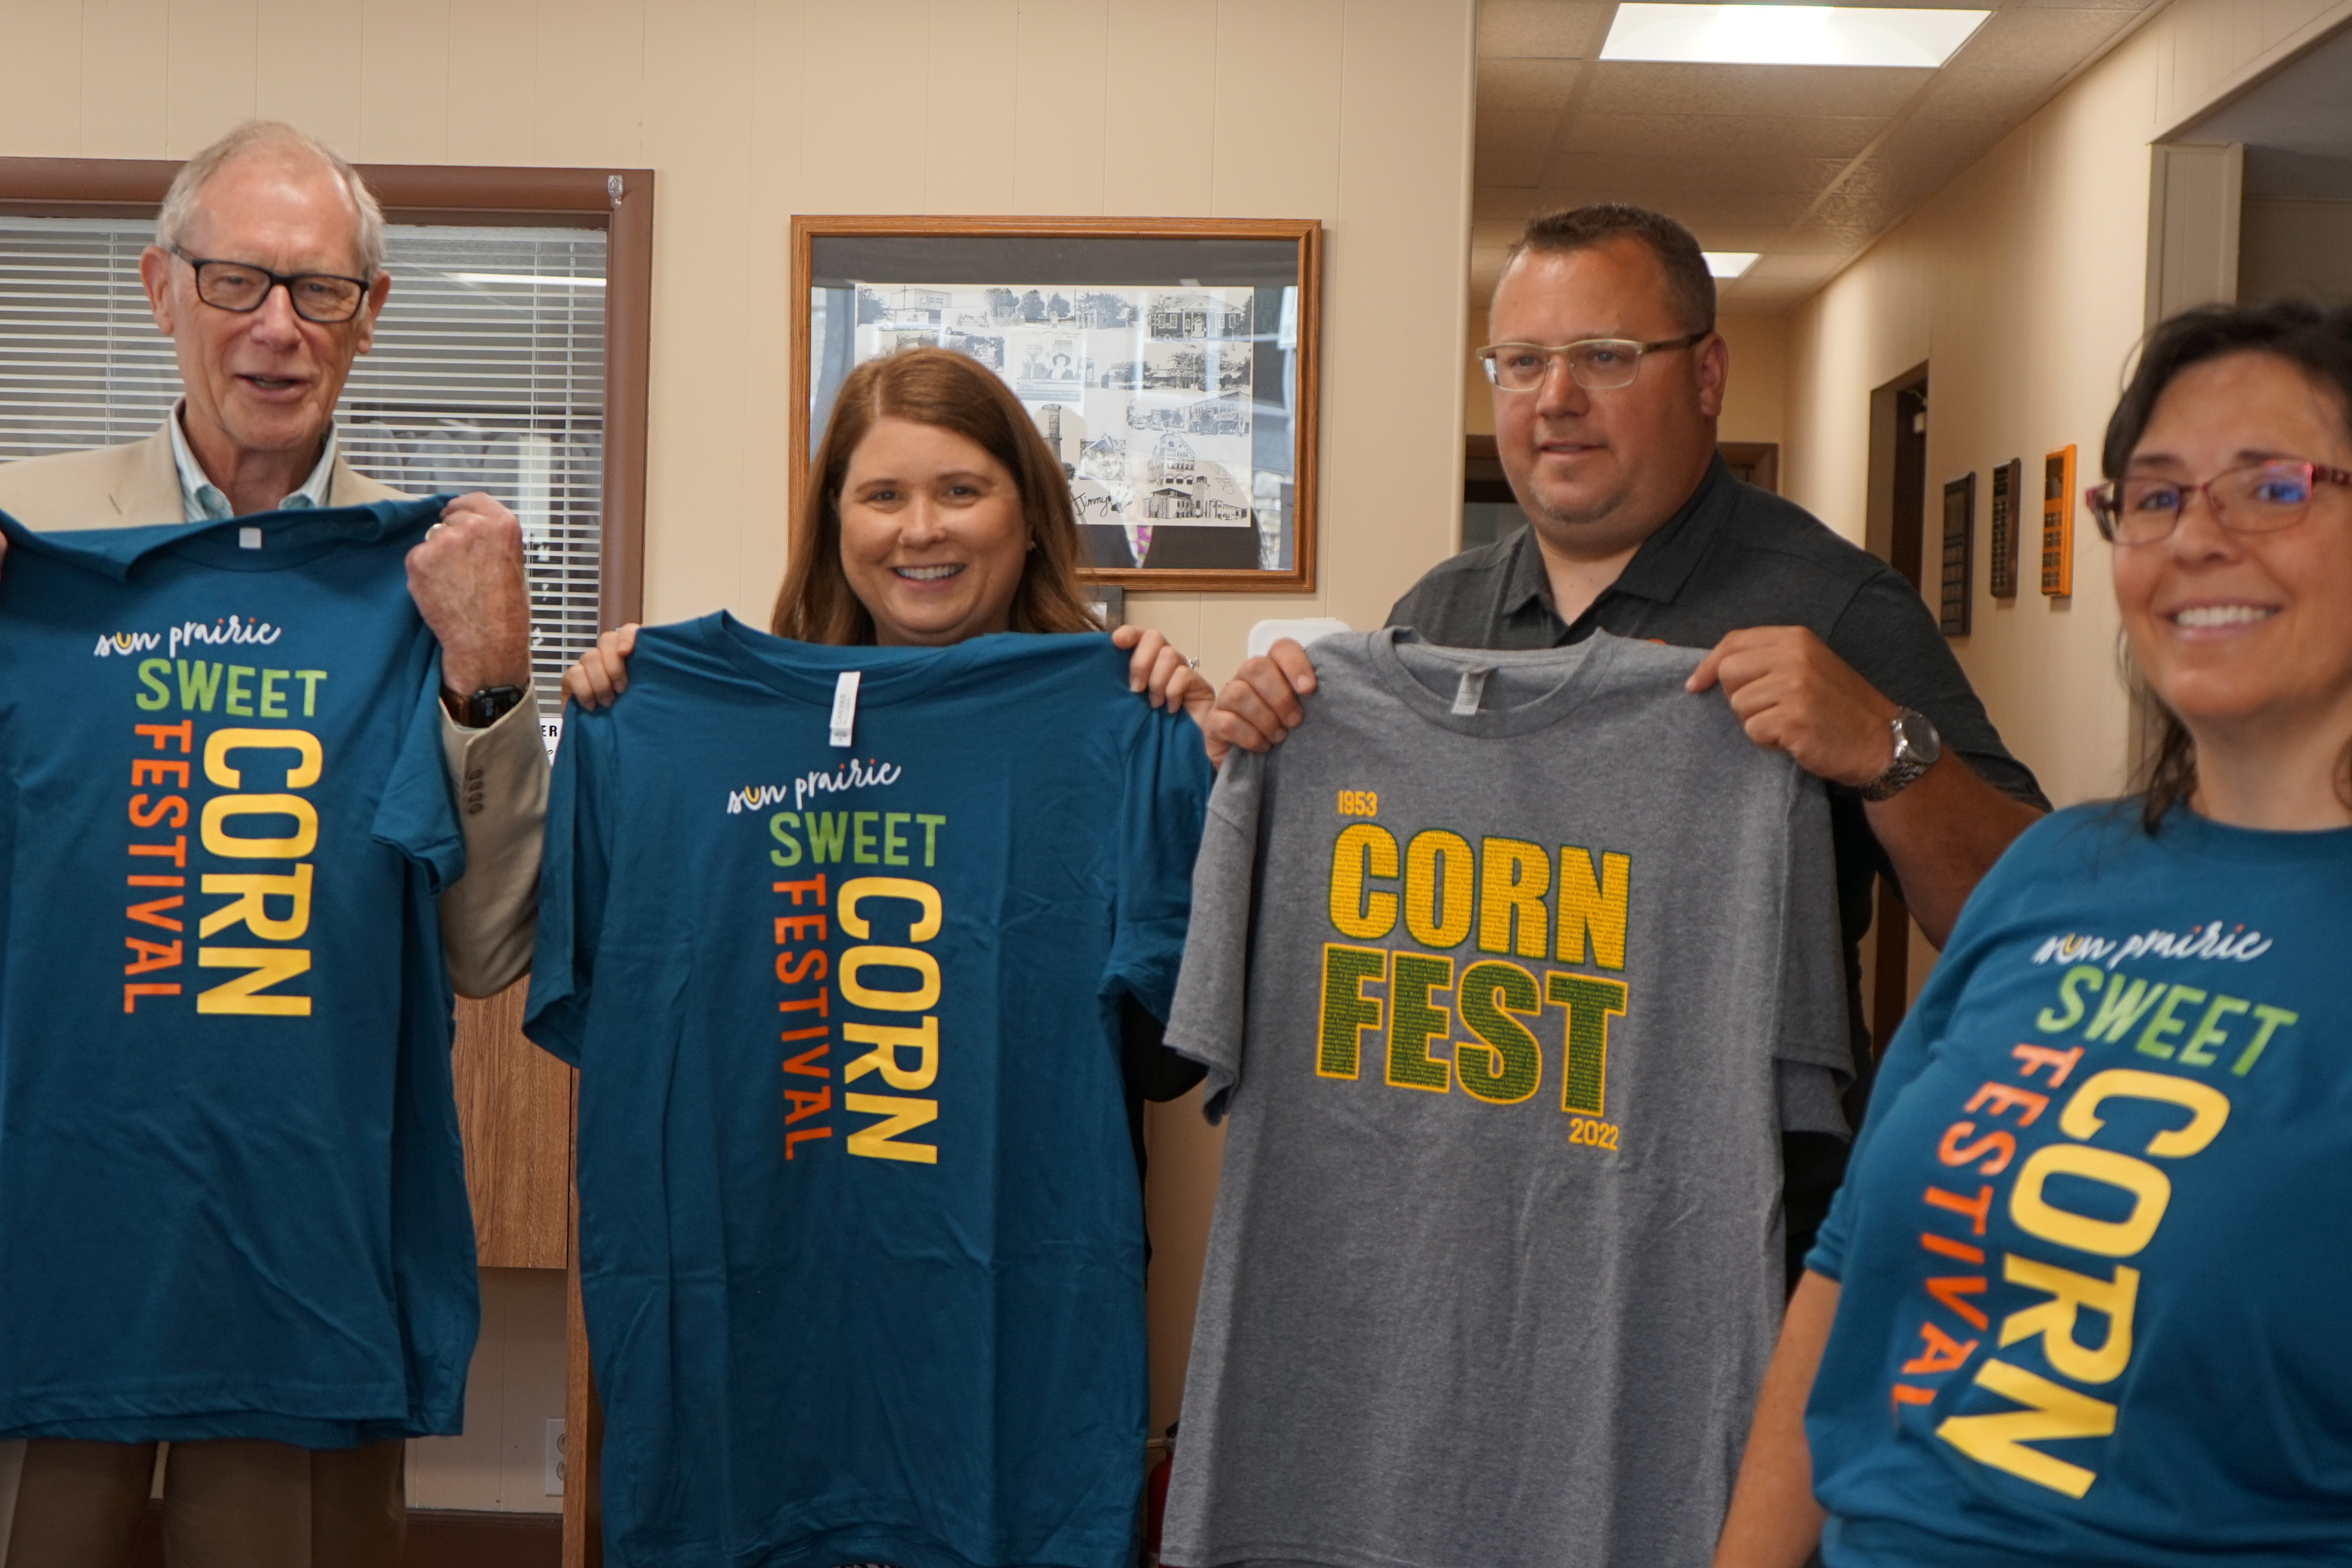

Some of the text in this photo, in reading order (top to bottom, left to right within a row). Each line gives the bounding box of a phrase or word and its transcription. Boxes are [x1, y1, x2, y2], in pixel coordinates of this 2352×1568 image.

[94, 614, 281, 659] sun prairie
[135, 657, 327, 718] SWEET
[726, 758, 902, 814] sun prairie
[769, 811, 947, 867] SWEET
[1337, 789, 1379, 817] 1953
[123, 719, 193, 1014] FESTIVAL
[197, 727, 323, 1016] CORN
[1328, 820, 1632, 972] CORN
[2032, 920, 2273, 970] sun prairie
[772, 873, 833, 1161] FESTIVAL
[837, 876, 943, 1165] CORN
[1316, 942, 1630, 1118] FEST
[2034, 964, 2300, 1077] SWEET
[1568, 1117, 1620, 1151] 2022
[1891, 1042, 2085, 1428] FESTIVAL
[1935, 1067, 2231, 1500] CORN
